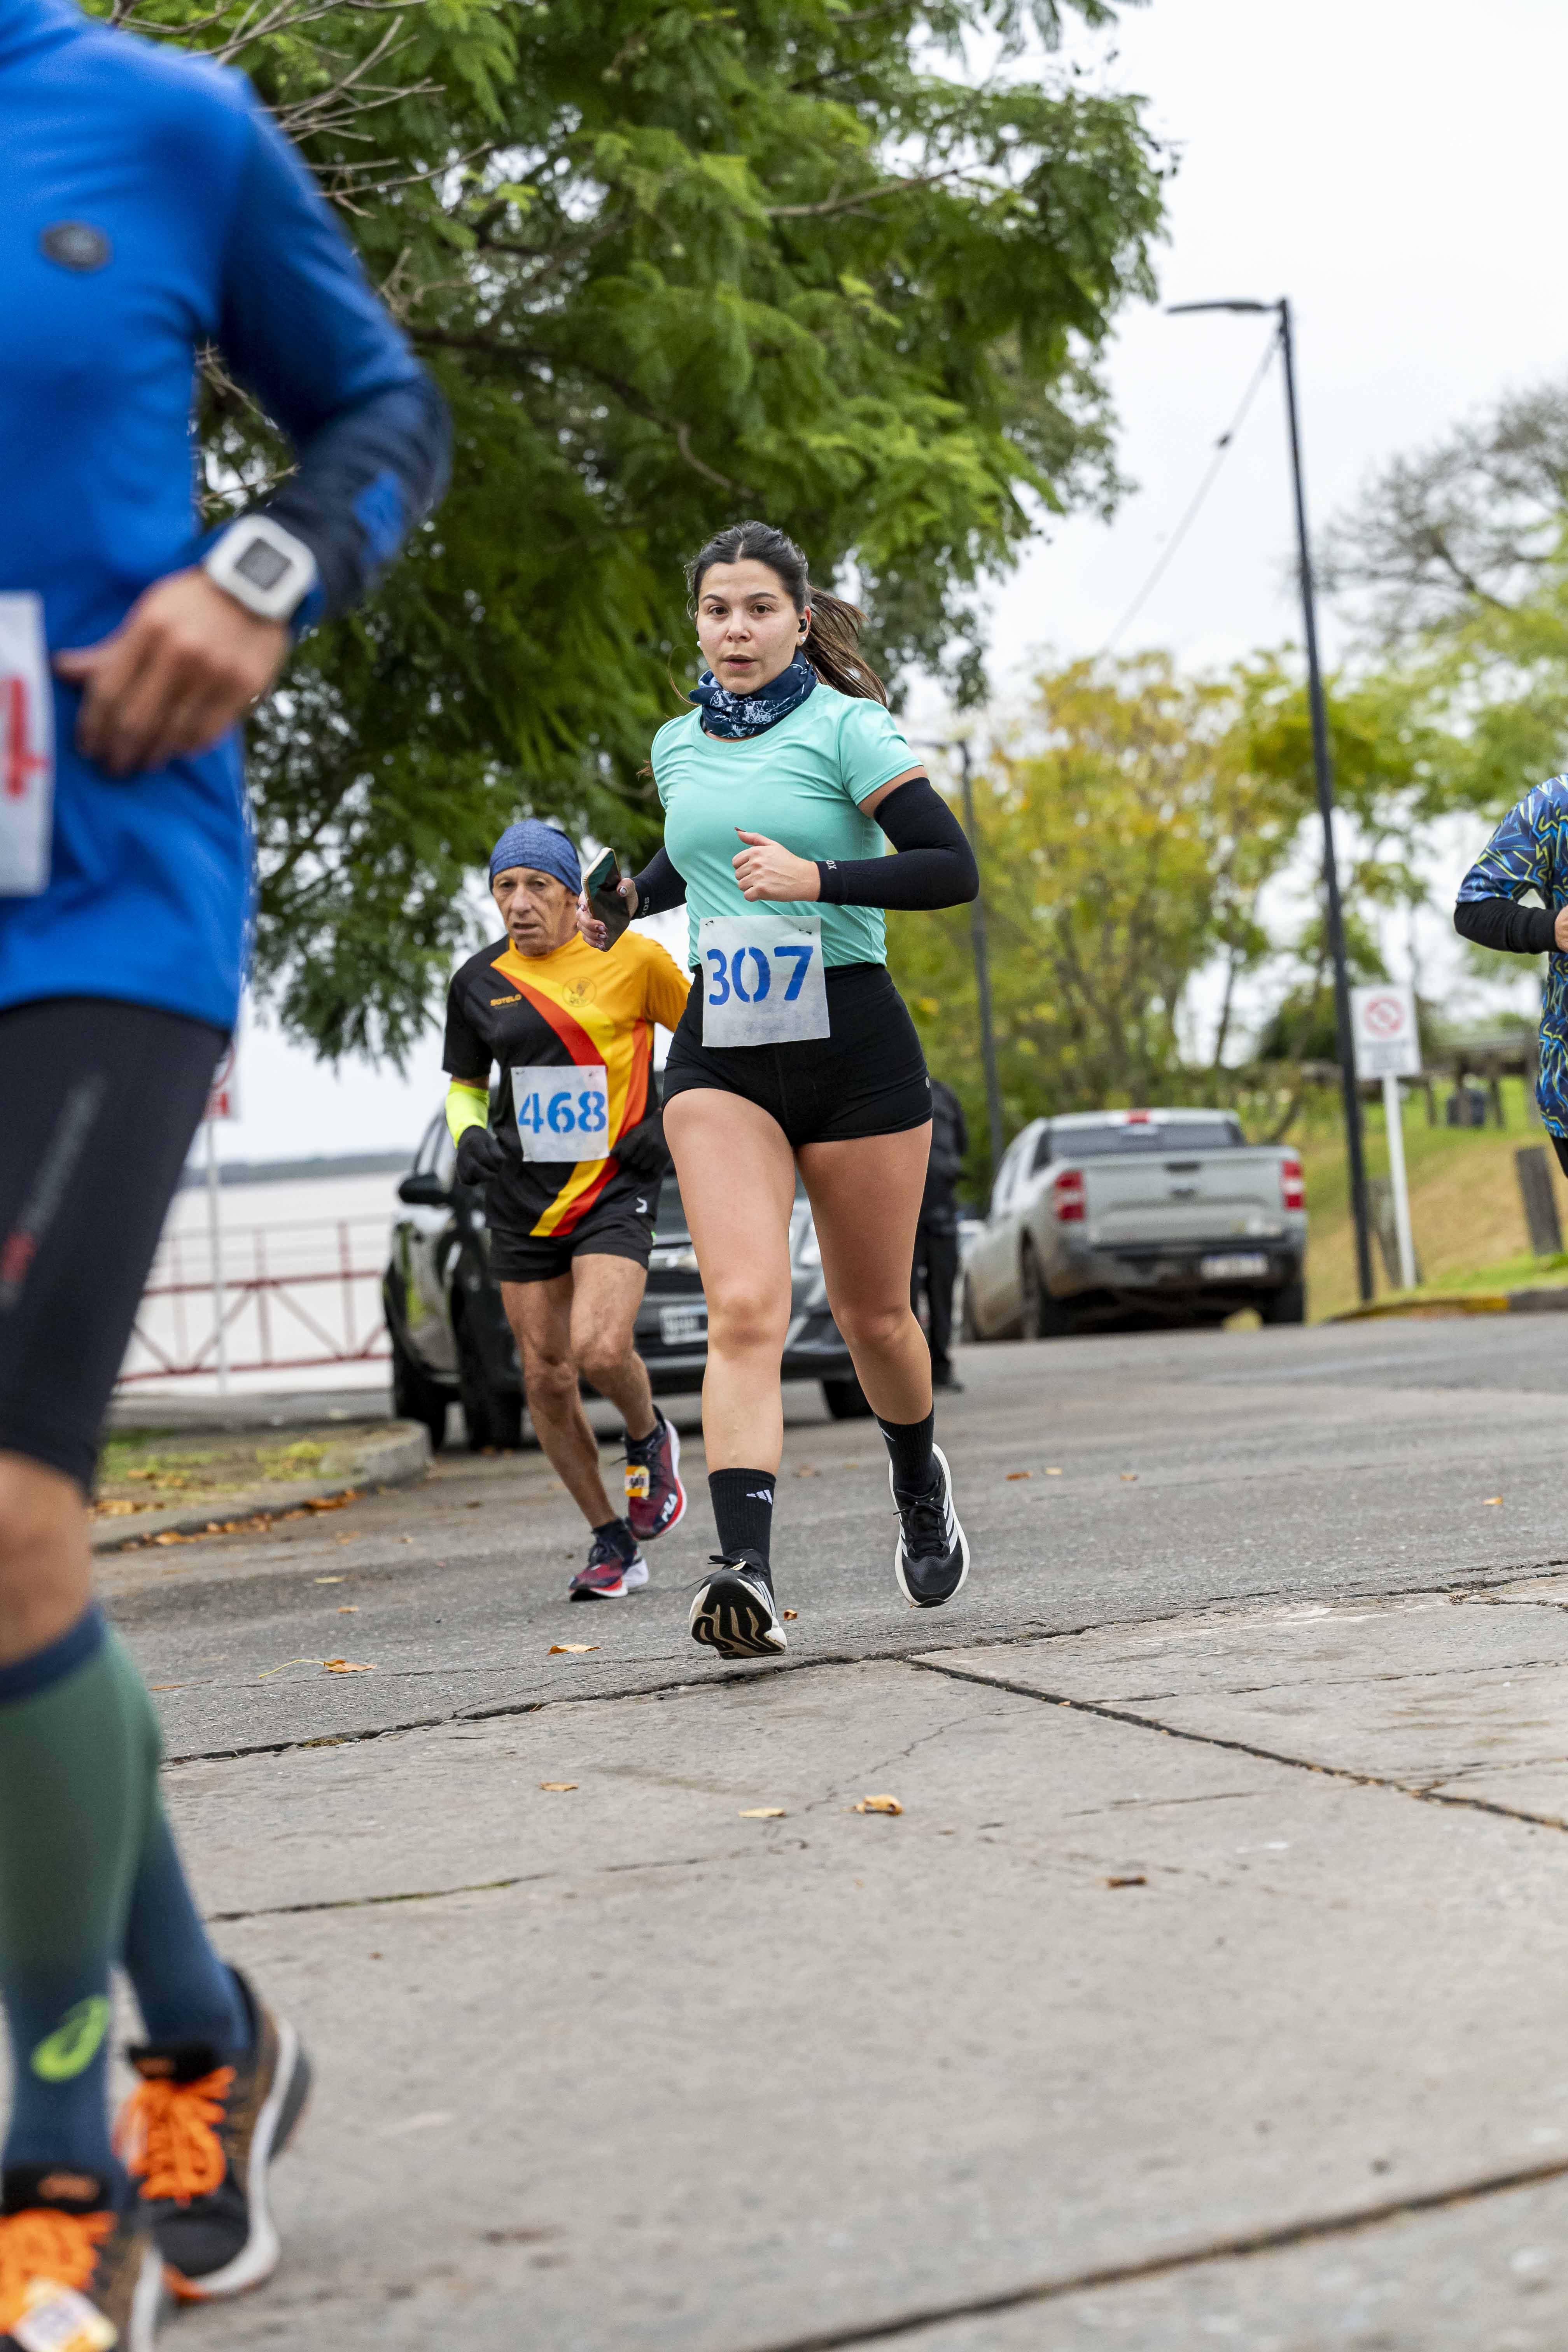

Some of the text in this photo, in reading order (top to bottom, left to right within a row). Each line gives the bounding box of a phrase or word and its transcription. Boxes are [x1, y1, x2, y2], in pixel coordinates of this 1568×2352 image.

[825, 859, 837, 870] OX
[707, 945, 814, 1006] 307
[490, 994, 522, 1006] SOTELO
[518, 1091, 606, 1133] 468
[662, 1493, 677, 1522] FILA
